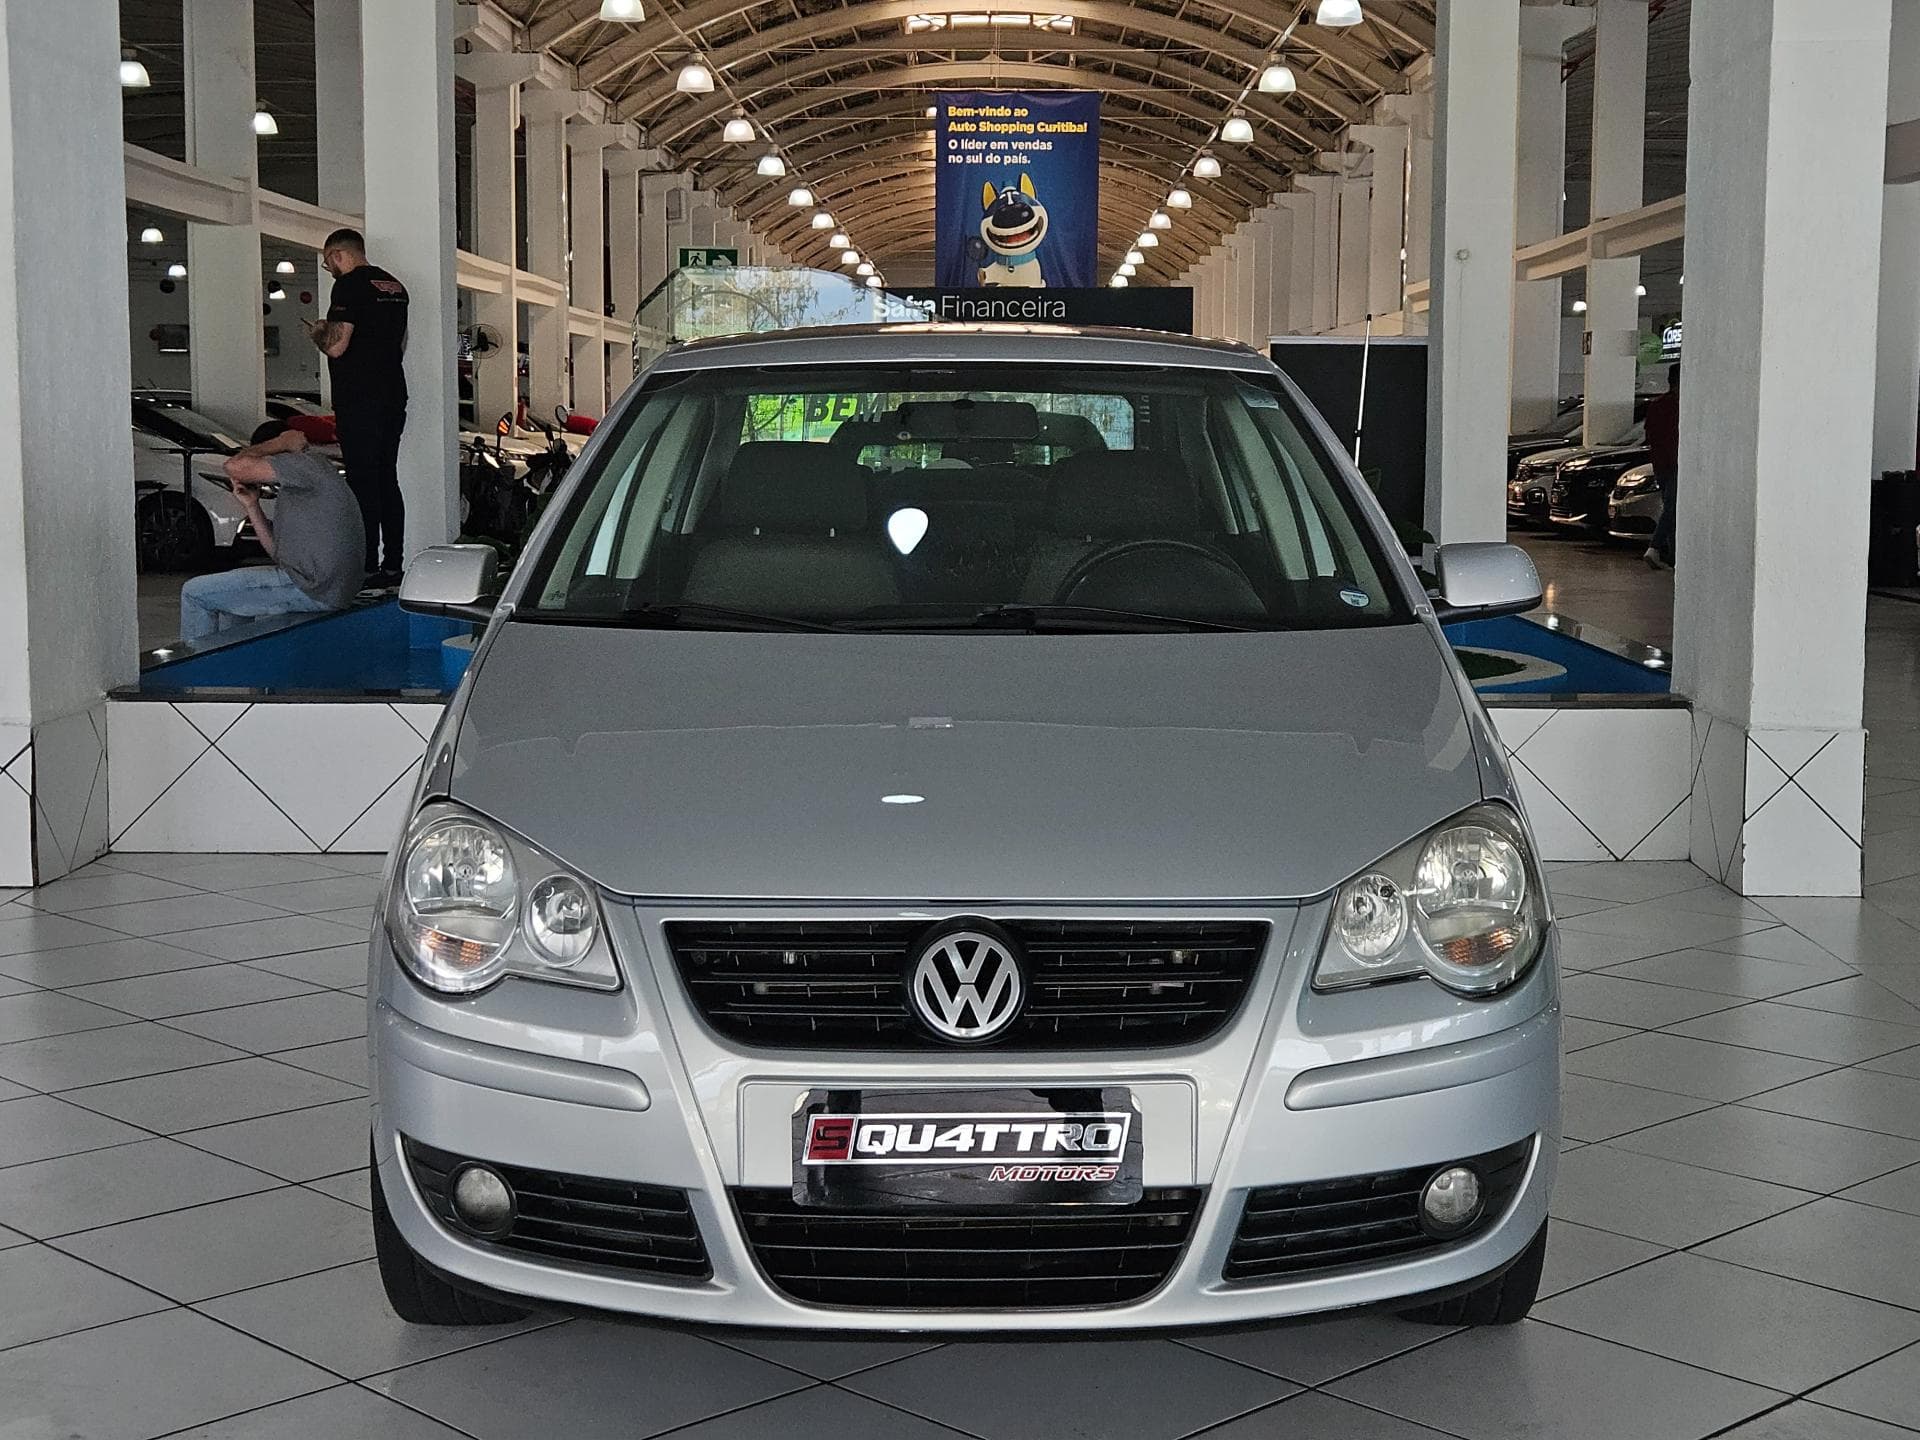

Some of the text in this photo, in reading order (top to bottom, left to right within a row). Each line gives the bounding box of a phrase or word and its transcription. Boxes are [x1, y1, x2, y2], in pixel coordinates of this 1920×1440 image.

[948, 106, 1029, 117] Bem-vindo ao
[948, 121, 1088, 134] Auto Shopping Curitiba!
[948, 138, 1053, 150] O líder em vendas
[948, 153, 1031, 166] no sul do país.
[941, 295, 1066, 318] Financeira
[988, 1165, 1120, 1182] MOTORS
